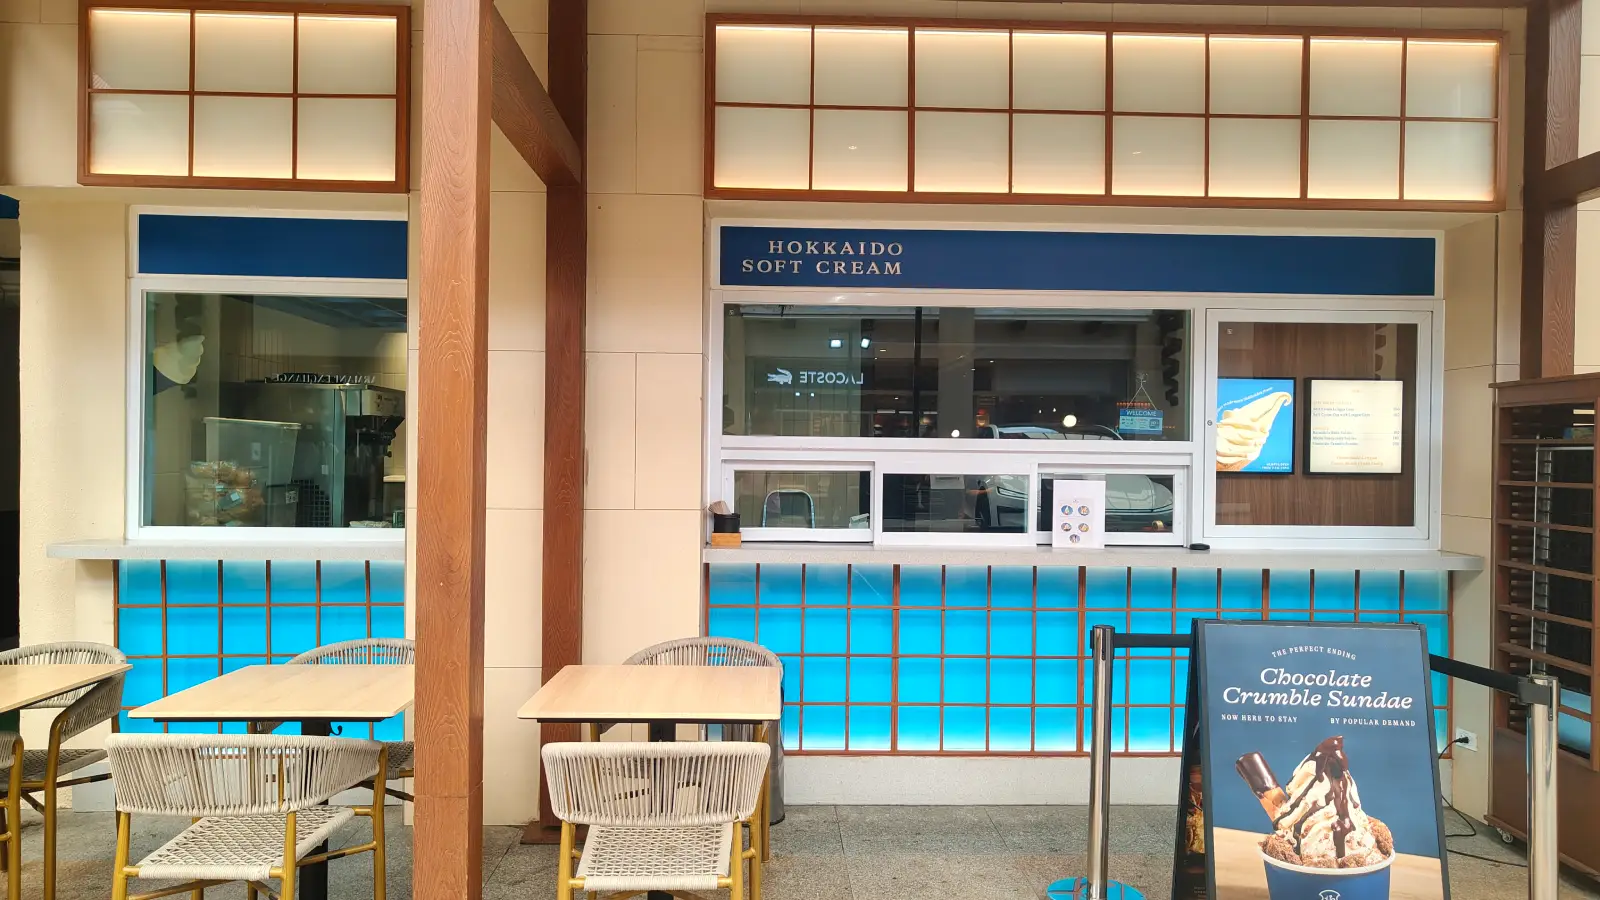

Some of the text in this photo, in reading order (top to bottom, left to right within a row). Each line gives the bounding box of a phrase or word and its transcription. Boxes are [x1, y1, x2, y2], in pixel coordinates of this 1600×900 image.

[768, 240, 903, 256] HOKKAIDO
[742, 259, 903, 275] SOFT CREAM
[1271, 645, 1357, 661] THE PERFECT ENDING
[1260, 668, 1373, 688] Chocolate
[1222, 686, 1413, 710] Crumble Sundae
[1221, 713, 1239, 721] NOW
[1241, 714, 1262, 722] HERE
[1330, 717, 1417, 727] BY POPULAR DEMAND
